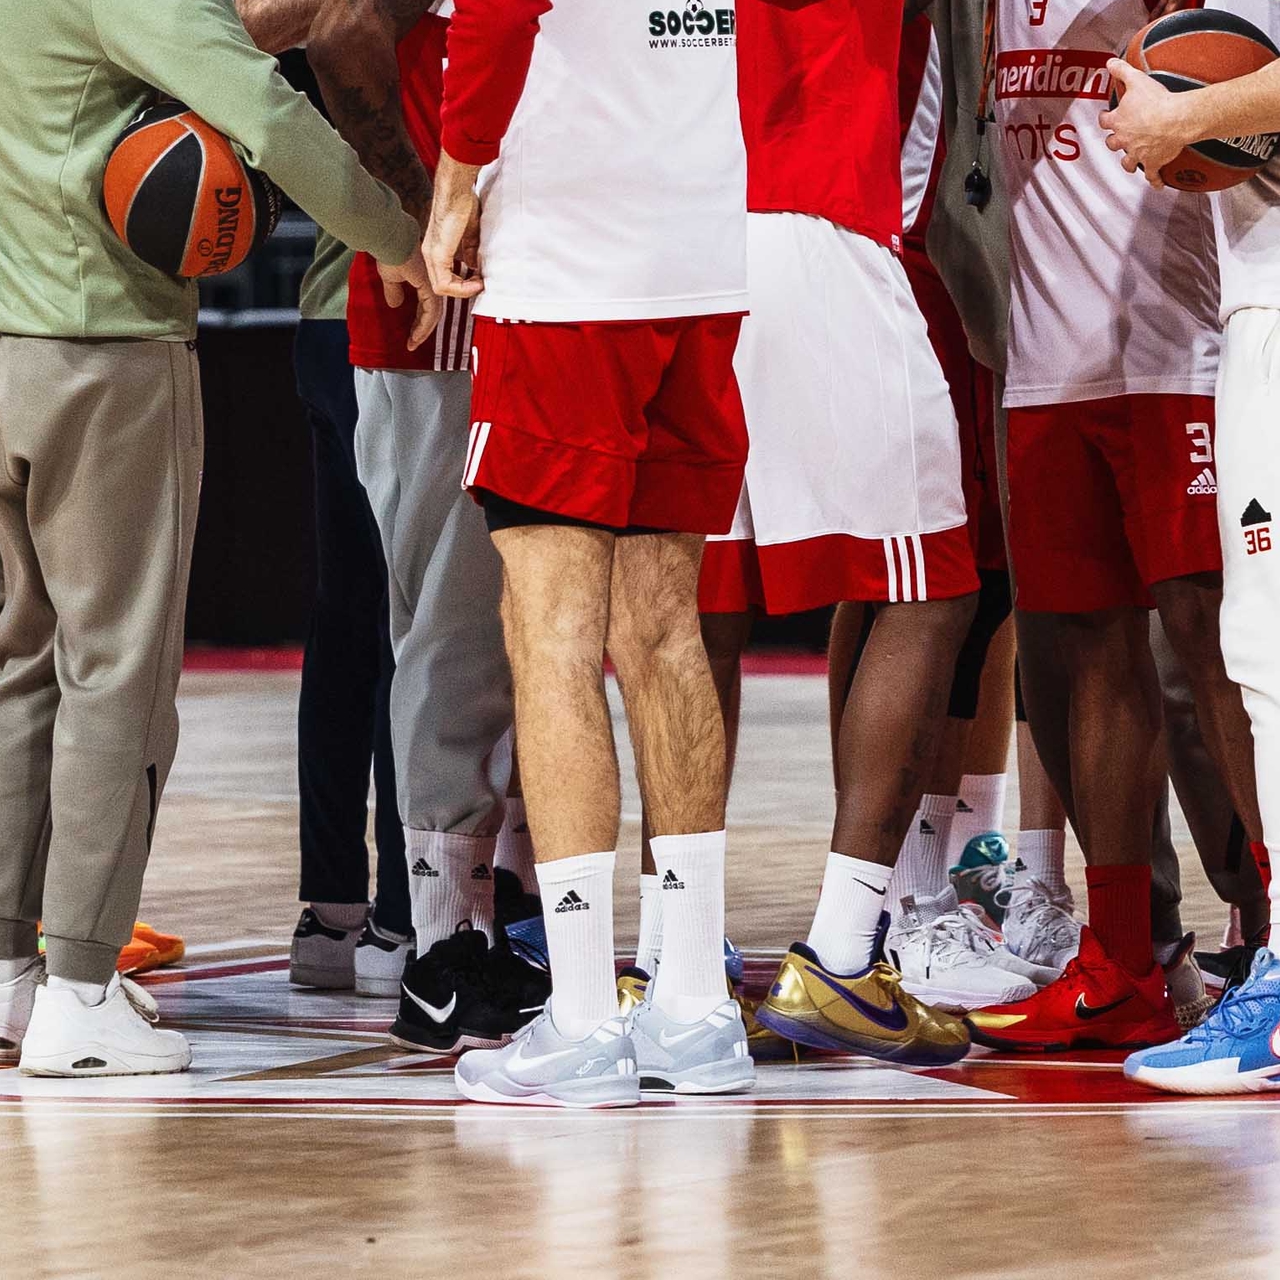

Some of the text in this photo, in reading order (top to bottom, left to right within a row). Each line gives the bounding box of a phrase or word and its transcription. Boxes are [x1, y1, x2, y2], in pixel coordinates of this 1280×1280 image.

[1004, 114, 1081, 161] mts
[1185, 422, 1213, 463] 3
[1186, 483, 1218, 495] adida
[1244, 526, 1272, 556] 36
